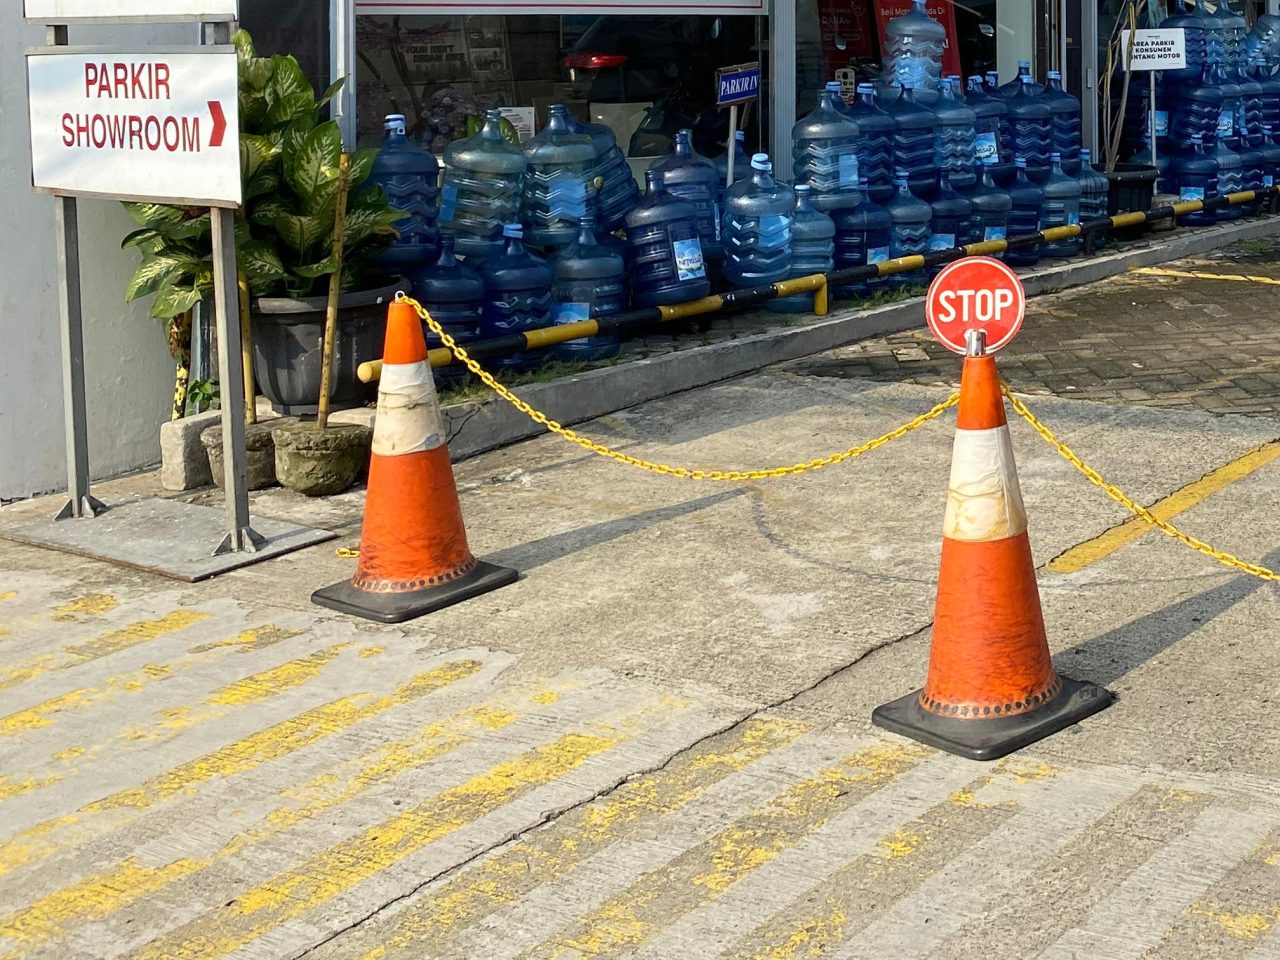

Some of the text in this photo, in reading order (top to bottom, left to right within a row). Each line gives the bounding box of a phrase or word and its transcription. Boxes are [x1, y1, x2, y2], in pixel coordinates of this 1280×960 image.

[85, 62, 171, 100] PARKIR
[721, 77, 749, 96] PARKIR
[62, 113, 200, 152] SHOWROOM
[938, 287, 1015, 324] STOP
